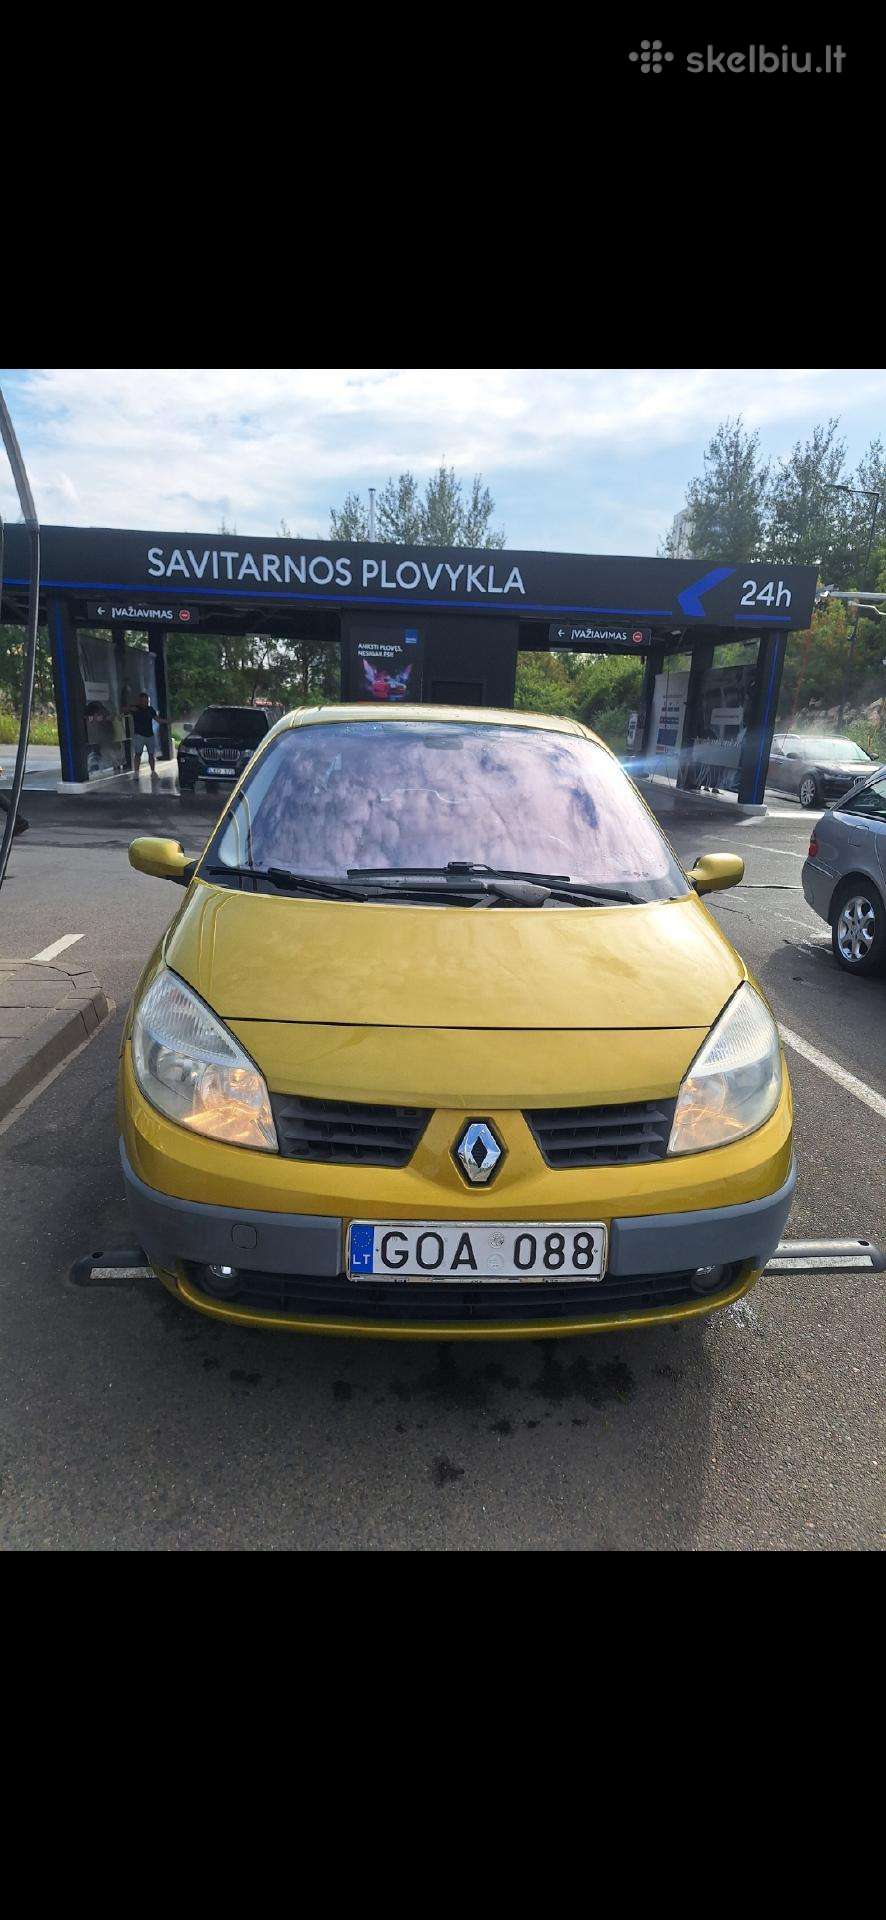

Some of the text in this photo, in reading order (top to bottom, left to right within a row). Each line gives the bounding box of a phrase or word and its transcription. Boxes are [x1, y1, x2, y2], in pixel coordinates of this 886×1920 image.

[147, 547, 526, 594] SAVITARNOS PLOVYKLA
[741, 580, 791, 607] 24h
[111, 606, 173, 619] ĮVAŽIAVIMAS
[570, 628, 627, 640] ĮVAŽIAVIMAS
[352, 1254, 371, 1265] LT
[380, 1231, 595, 1270] GOA 088
